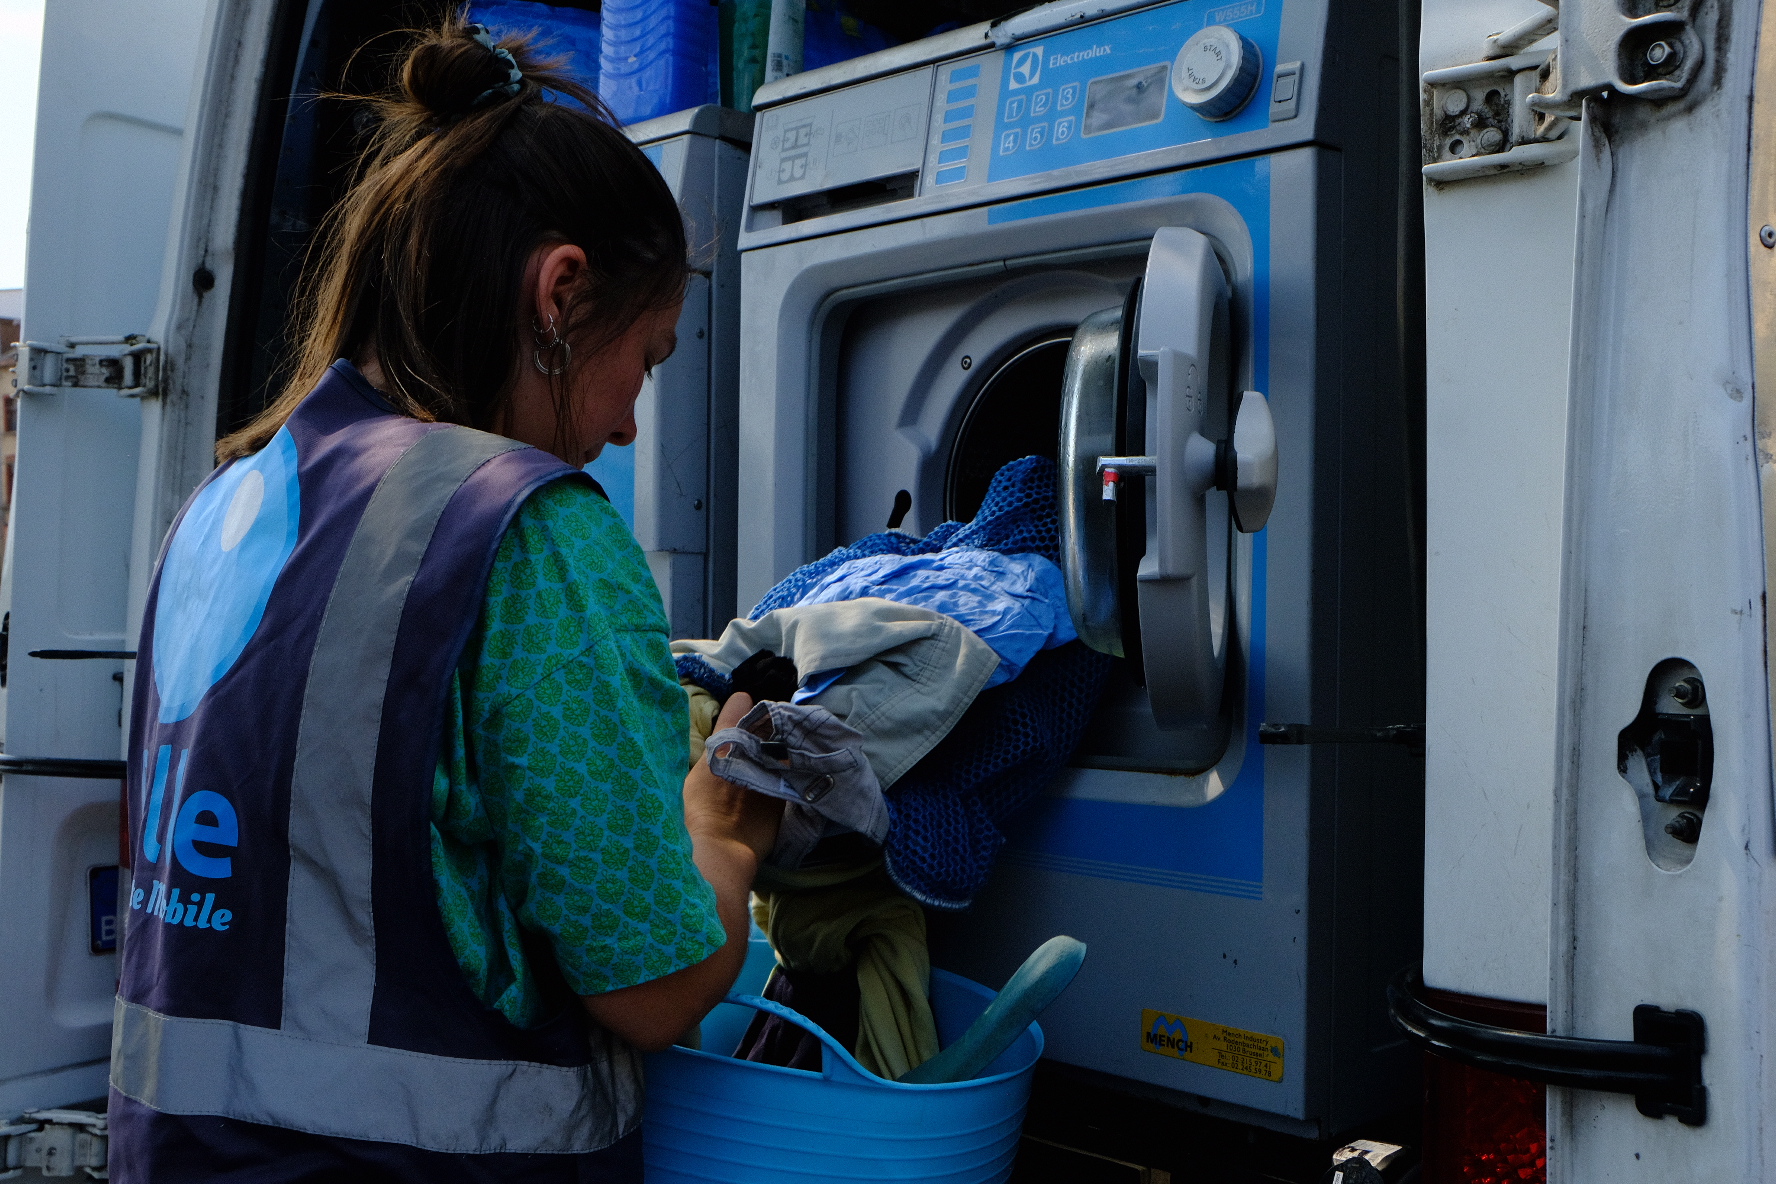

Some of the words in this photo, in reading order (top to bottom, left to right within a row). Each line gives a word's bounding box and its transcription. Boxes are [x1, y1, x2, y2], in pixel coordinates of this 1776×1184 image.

[1215, 2, 1257, 22] W555H
[1049, 44, 1112, 68] Electrolux
[1203, 44, 1223, 62] START
[1187, 66, 1206, 85] START
[1011, 101, 1018, 117] 1
[1035, 95, 1046, 111] 2
[1062, 88, 1073, 104] 3
[1004, 134, 1014, 150] 4
[1031, 128, 1041, 144] 5
[1058, 122, 1068, 139] 6
[101, 915, 117, 941] B
[1146, 1032, 1193, 1053] MENCH
[1212, 1034, 1221, 1042] Av.
[1223, 1037, 1269, 1053] Rodenbachlaan
[1222, 1029, 1242, 1039] Mench
[1243, 1034, 1269, 1046] Industry
[1226, 1043, 1241, 1053] 1030
